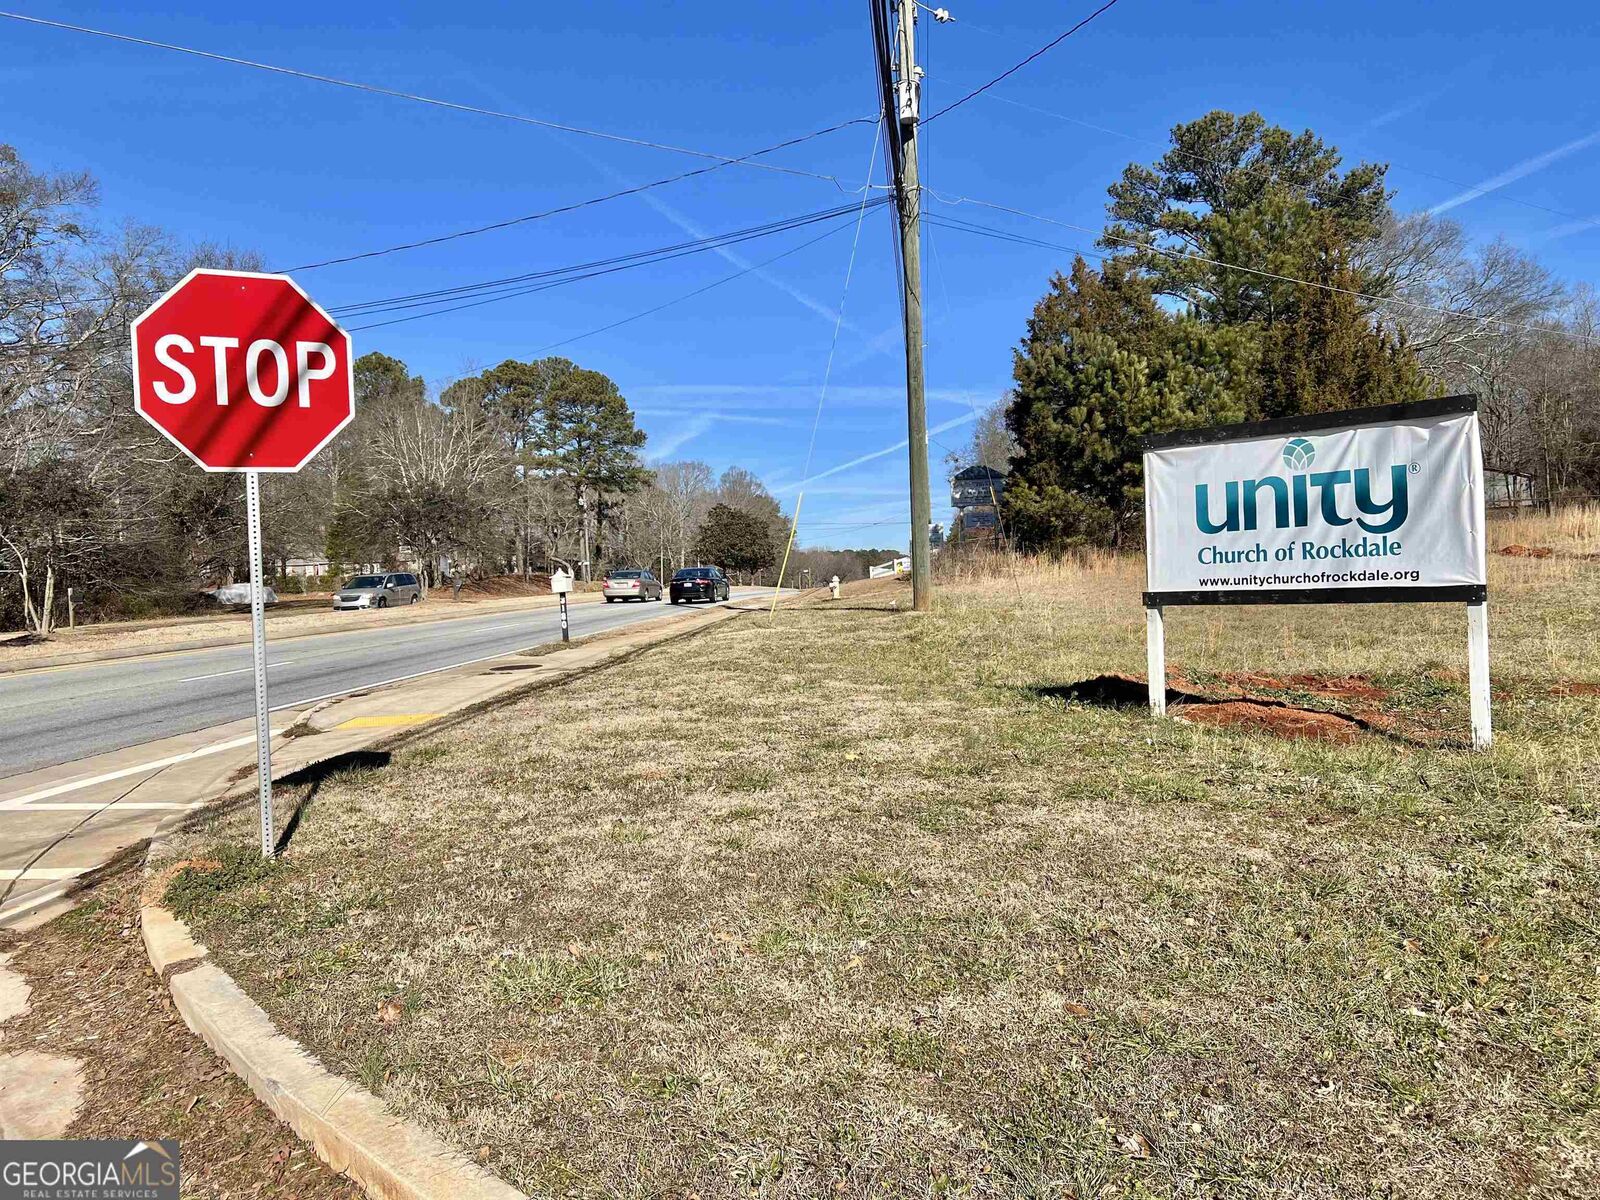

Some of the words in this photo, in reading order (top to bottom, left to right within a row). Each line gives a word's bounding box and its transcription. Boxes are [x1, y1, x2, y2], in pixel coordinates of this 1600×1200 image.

[152, 334, 337, 408] STOP
[1197, 543, 1268, 565] Church
[1275, 542, 1296, 561] of
[1302, 536, 1402, 560] Rockdale
[1199, 569, 1420, 587] www.unitychurchofrockdale.org
